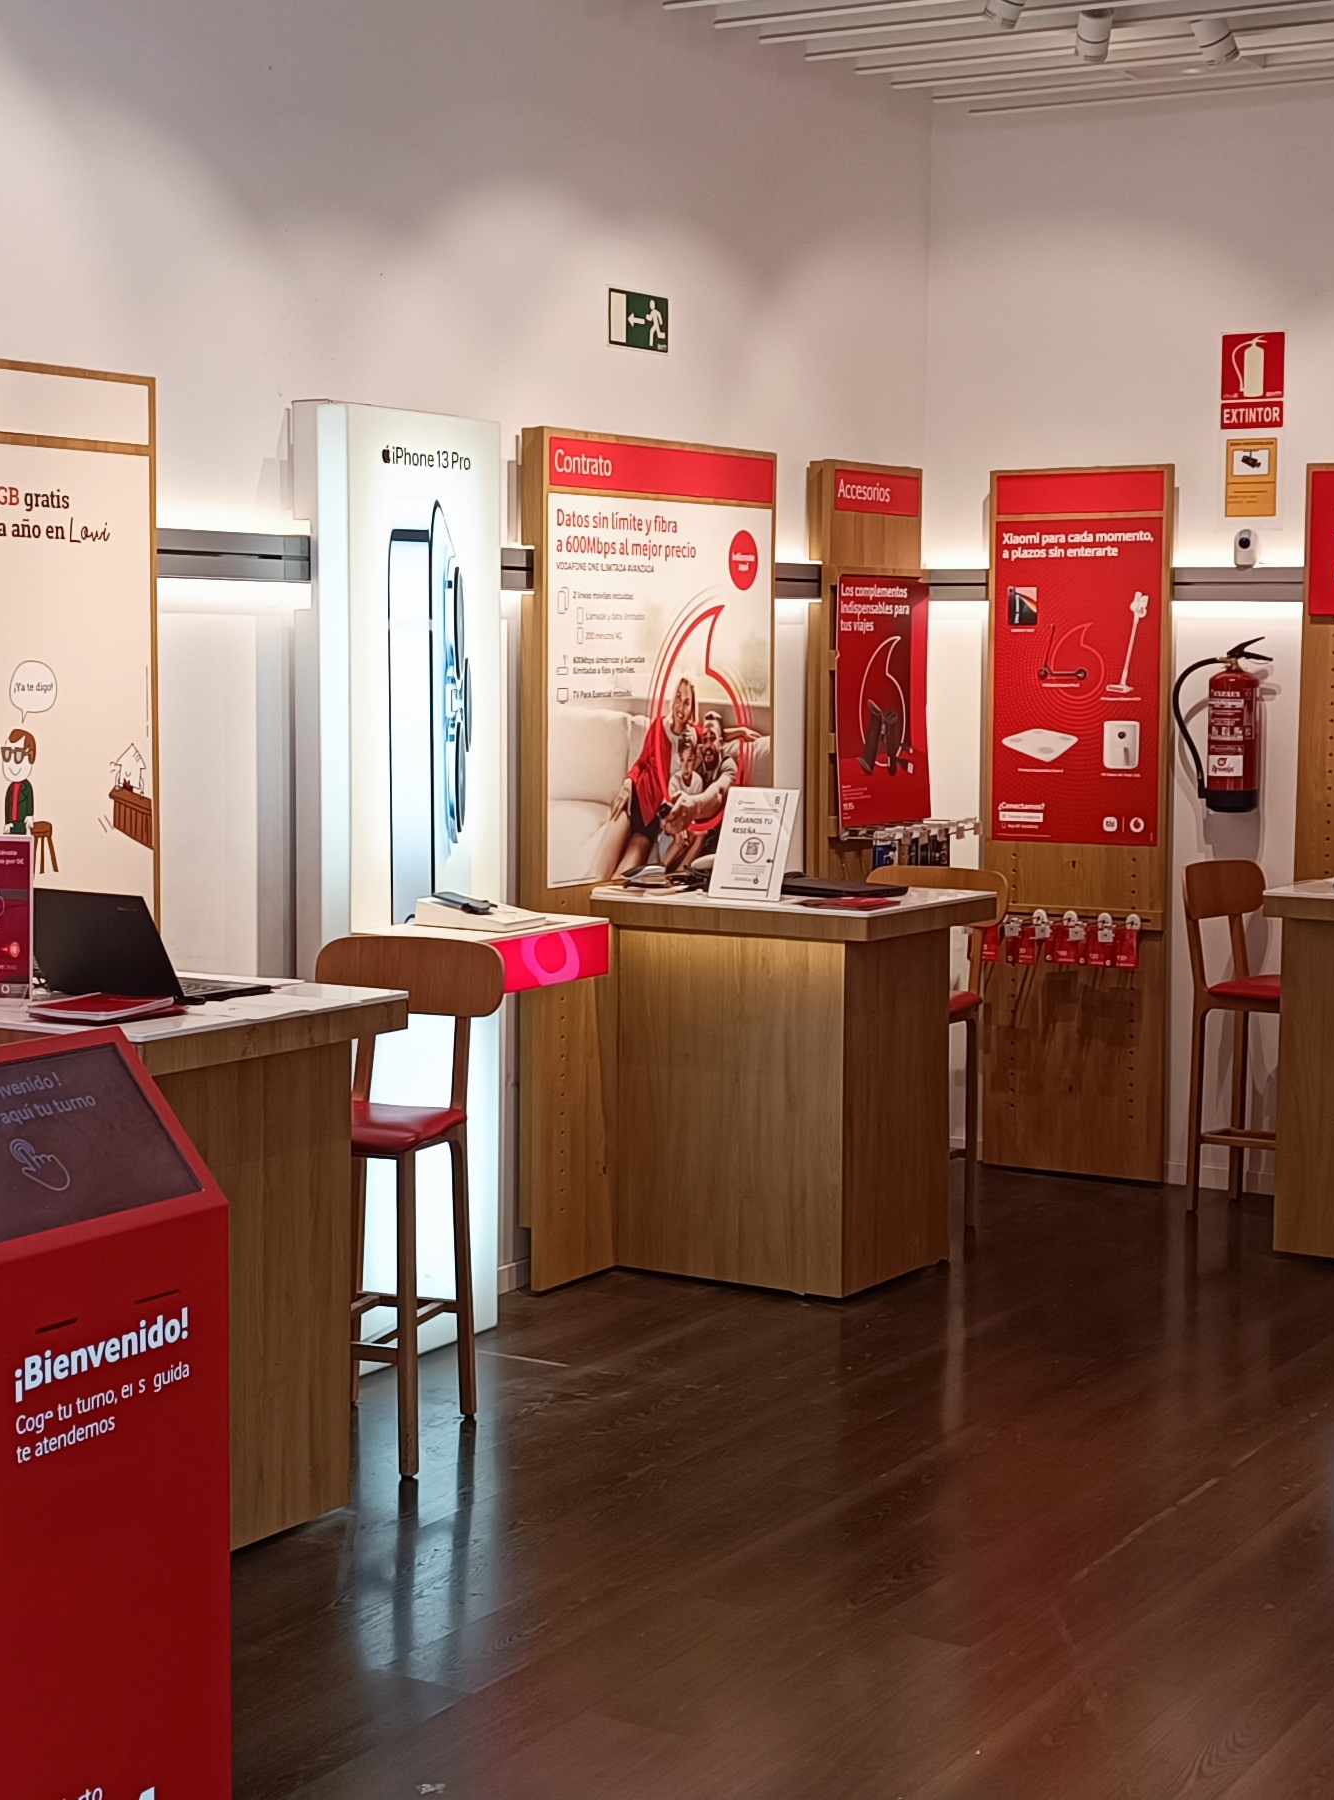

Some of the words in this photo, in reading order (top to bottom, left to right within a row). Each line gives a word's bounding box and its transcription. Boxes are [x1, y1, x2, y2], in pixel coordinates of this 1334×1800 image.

[1224, 407, 1280, 423] EXTINTOR
[392, 446, 434, 468] iPhone
[436, 450, 449, 469] 13
[451, 451, 471, 471] Pro
[554, 449, 612, 477] Contrato
[23, 489, 70, 512] gratis
[838, 479, 891, 502] Accesorios
[11, 518, 41, 539] año
[46, 523, 66, 539] en
[557, 508, 590, 529] Datos
[593, 511, 608, 529] sin
[611, 511, 643, 532] límite
[645, 519, 653, 537] y
[654, 515, 678, 533] fibra
[556, 539, 562, 552] a
[565, 536, 616, 560] 600Mbps
[619, 540, 629, 556] al
[631, 542, 663, 561] mejor
[665, 541, 696, 562] precio
[1002, 532, 1040, 544] Xiaomi
[1041, 534, 1066, 546] para
[1067, 530, 1093, 543] cada
[1095, 531, 1154, 543] momento,
[1002, 550, 1009, 559] a
[1011, 547, 1047, 561] plazos
[1048, 546, 1065, 557] sin
[1067, 546, 1118, 557] enterarte
[841, 583, 854, 597] Los
[855, 584, 908, 601] complementos
[840, 619, 852, 631] tus
[854, 619, 874, 635] viajes
[14, 683, 25, 694] ¡Ya
[27, 683, 34, 691] te
[35, 682, 54, 694] digo!
[732, 826, 756, 834] RESEÑA
[0, 1103, 34, 1126] aquí
[34, 1103, 53, 1117] tu
[53, 1095, 96, 1113] turno
[15, 1306, 189, 1403] ¡Bienvenido!
[16, 1446, 31, 1465] te
[35, 1416, 116, 1457] atendemos
